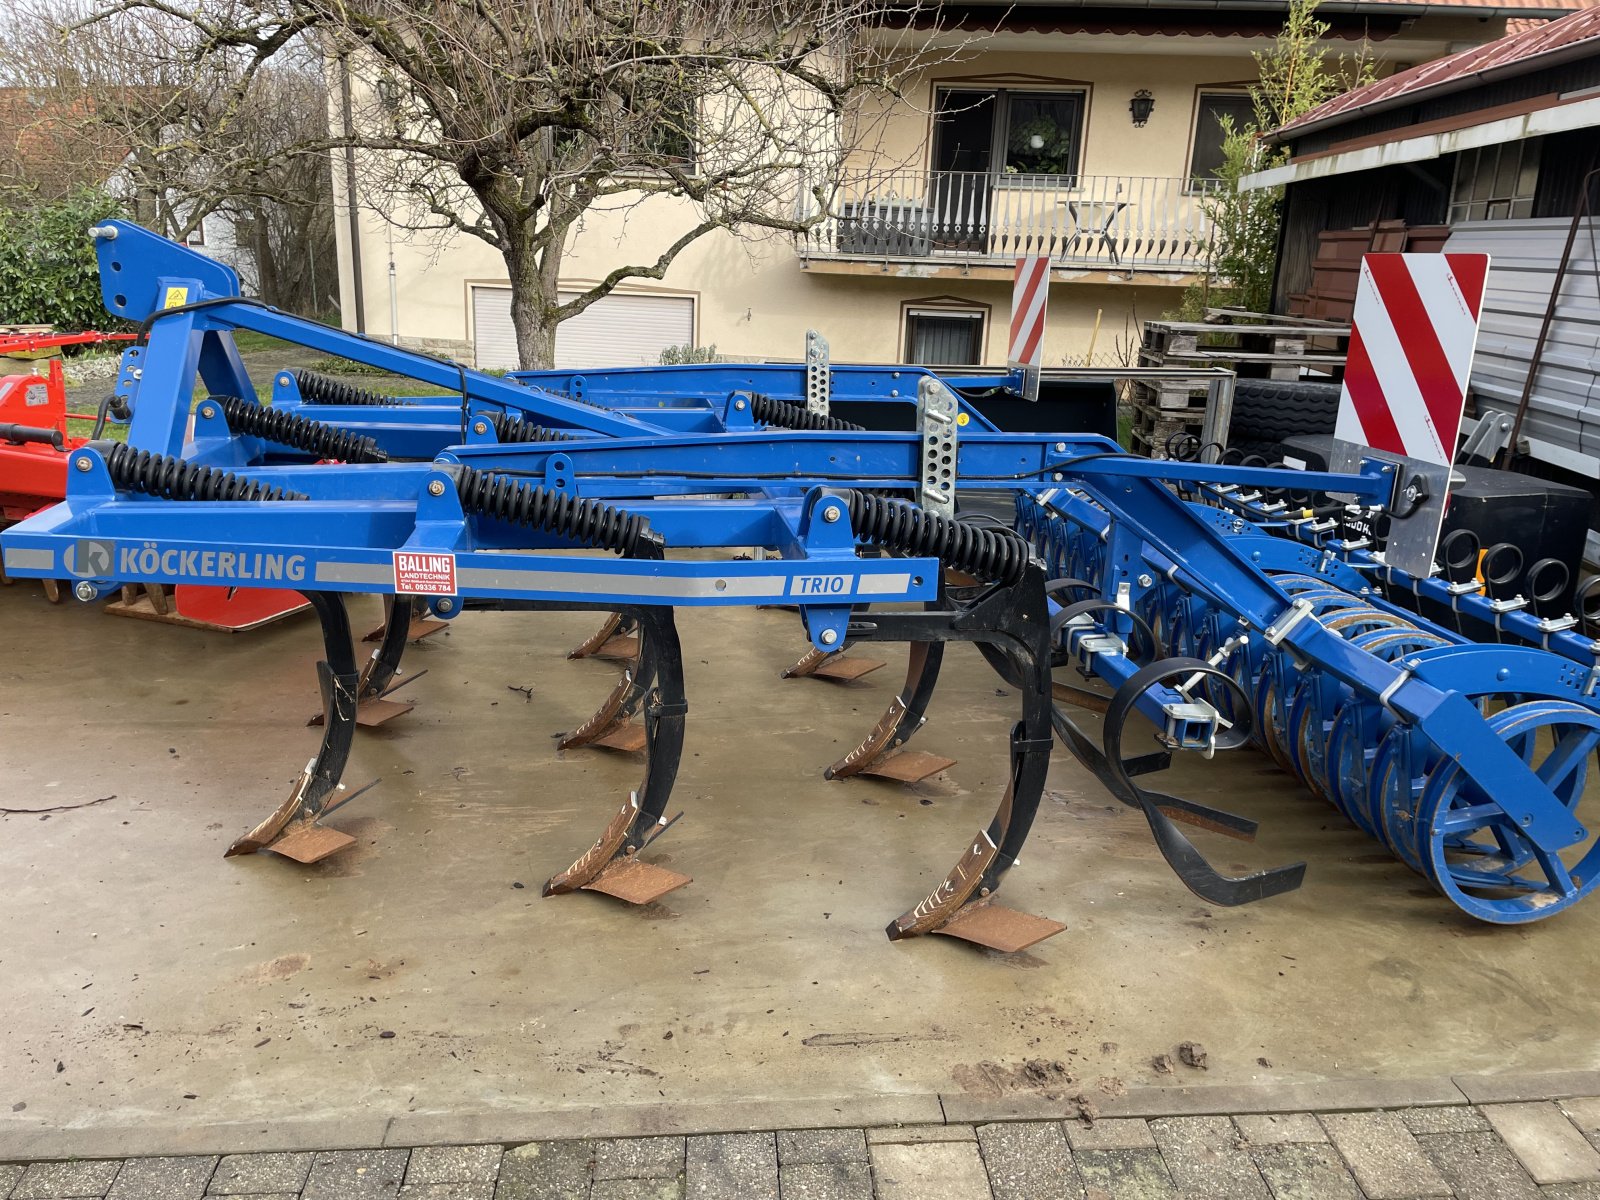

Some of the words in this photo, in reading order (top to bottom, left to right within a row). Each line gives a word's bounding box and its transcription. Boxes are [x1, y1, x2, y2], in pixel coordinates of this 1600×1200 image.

[120, 542, 306, 581] KÖCKERLING
[398, 555, 451, 573] BALLING
[400, 572, 450, 581] LANDTECHNIK
[800, 576, 844, 594] TRIO
[400, 582, 414, 591] Tel.
